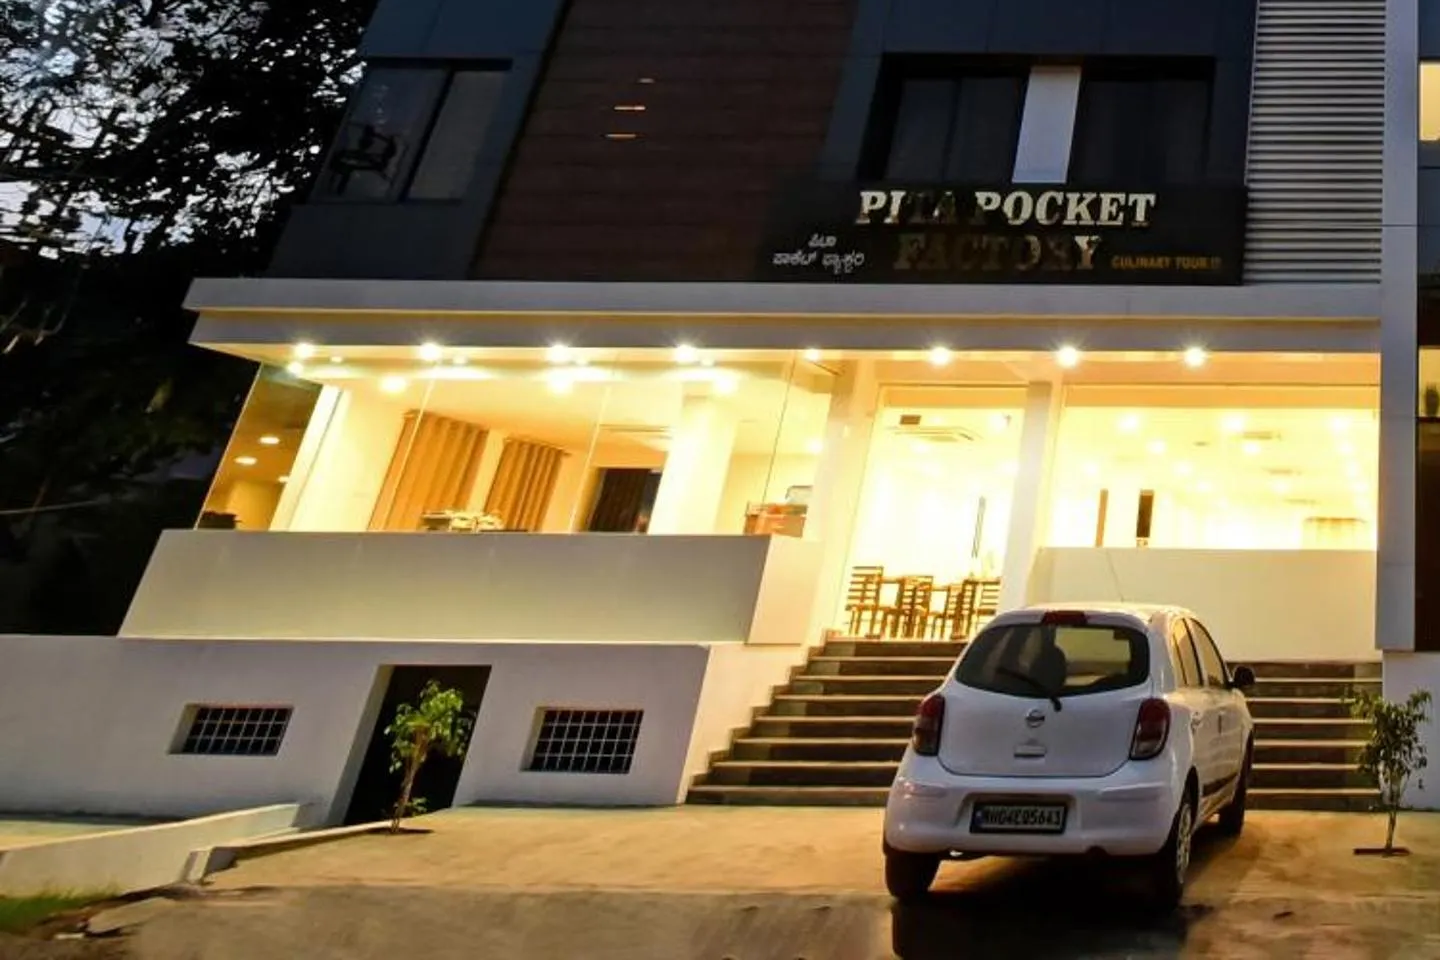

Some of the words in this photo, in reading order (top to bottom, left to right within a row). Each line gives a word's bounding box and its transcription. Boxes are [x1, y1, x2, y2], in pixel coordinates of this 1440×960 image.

[855, 190, 957, 226] PITA
[969, 190, 1157, 226] POCKET
[893, 233, 1103, 271] FACTORY
[1111, 254, 1171, 271] CULINARY
